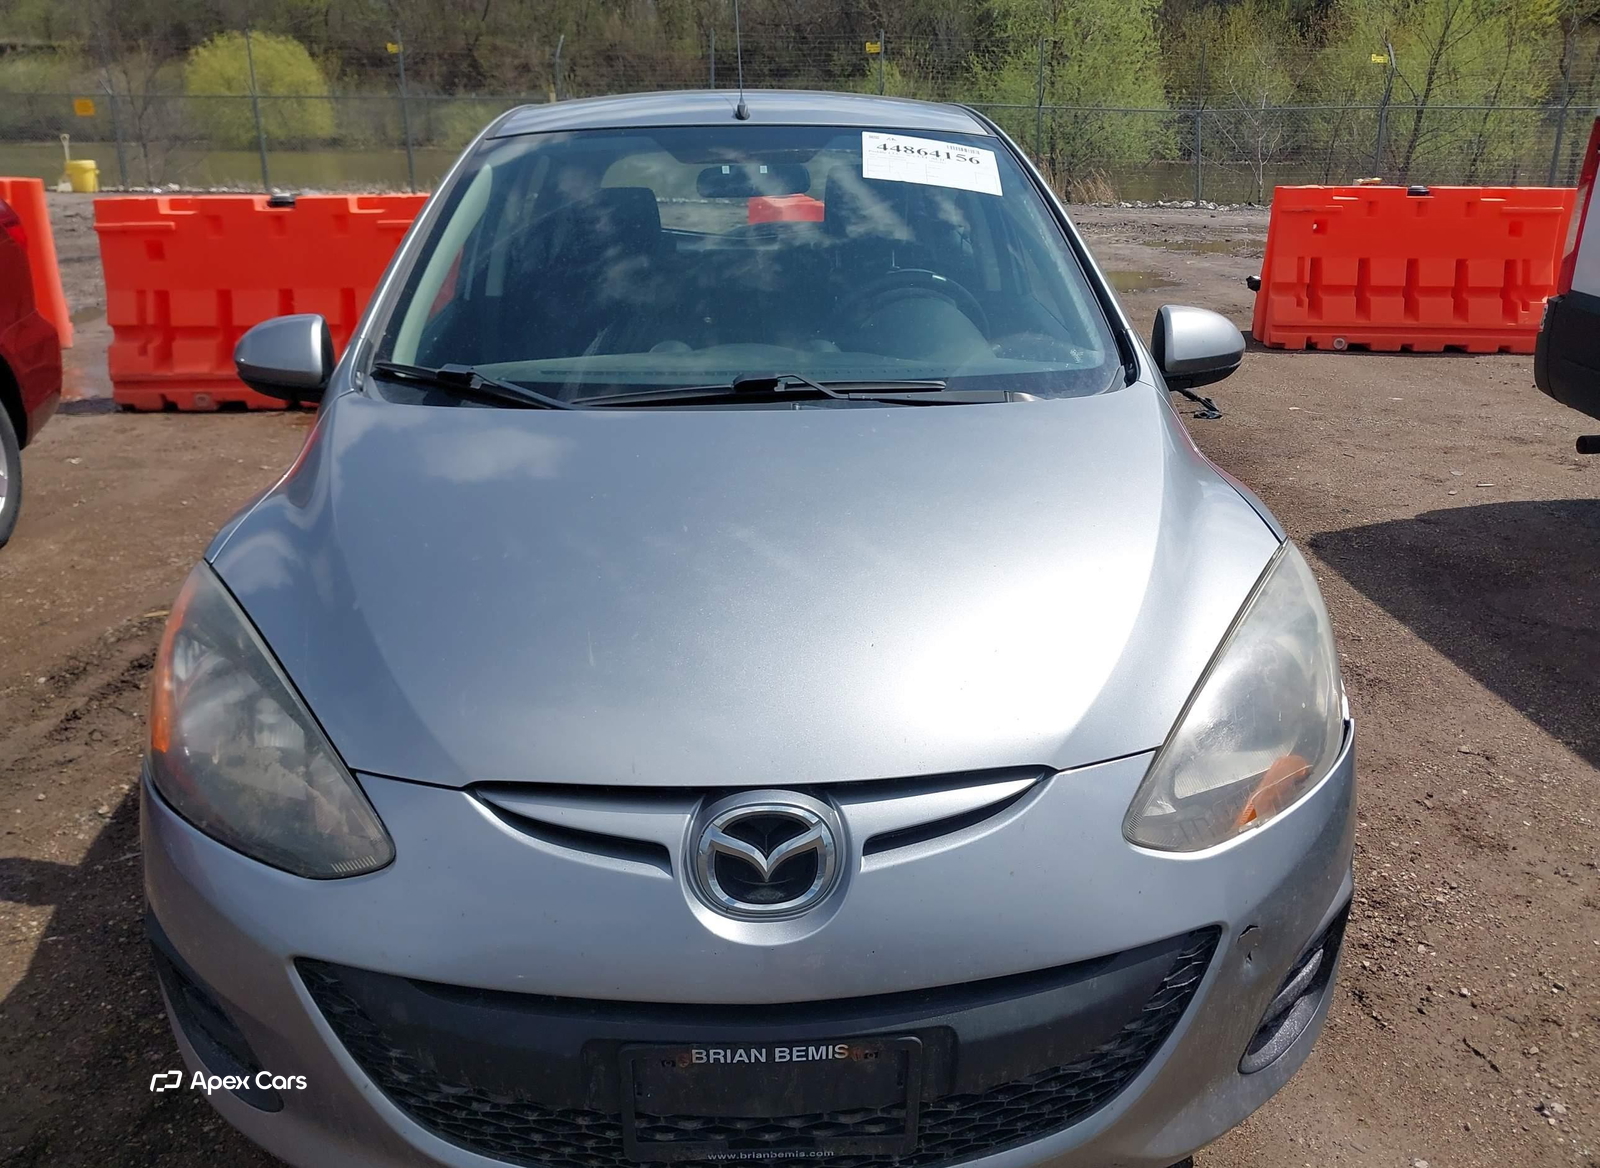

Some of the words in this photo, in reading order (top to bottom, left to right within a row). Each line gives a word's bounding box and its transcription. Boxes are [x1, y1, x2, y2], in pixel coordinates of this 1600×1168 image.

[877, 143, 980, 165] 44864156
[691, 1048, 766, 1064] BRIAN
[774, 1044, 849, 1063] BEMIS
[707, 1150, 834, 1160] www.brianbemis.com
